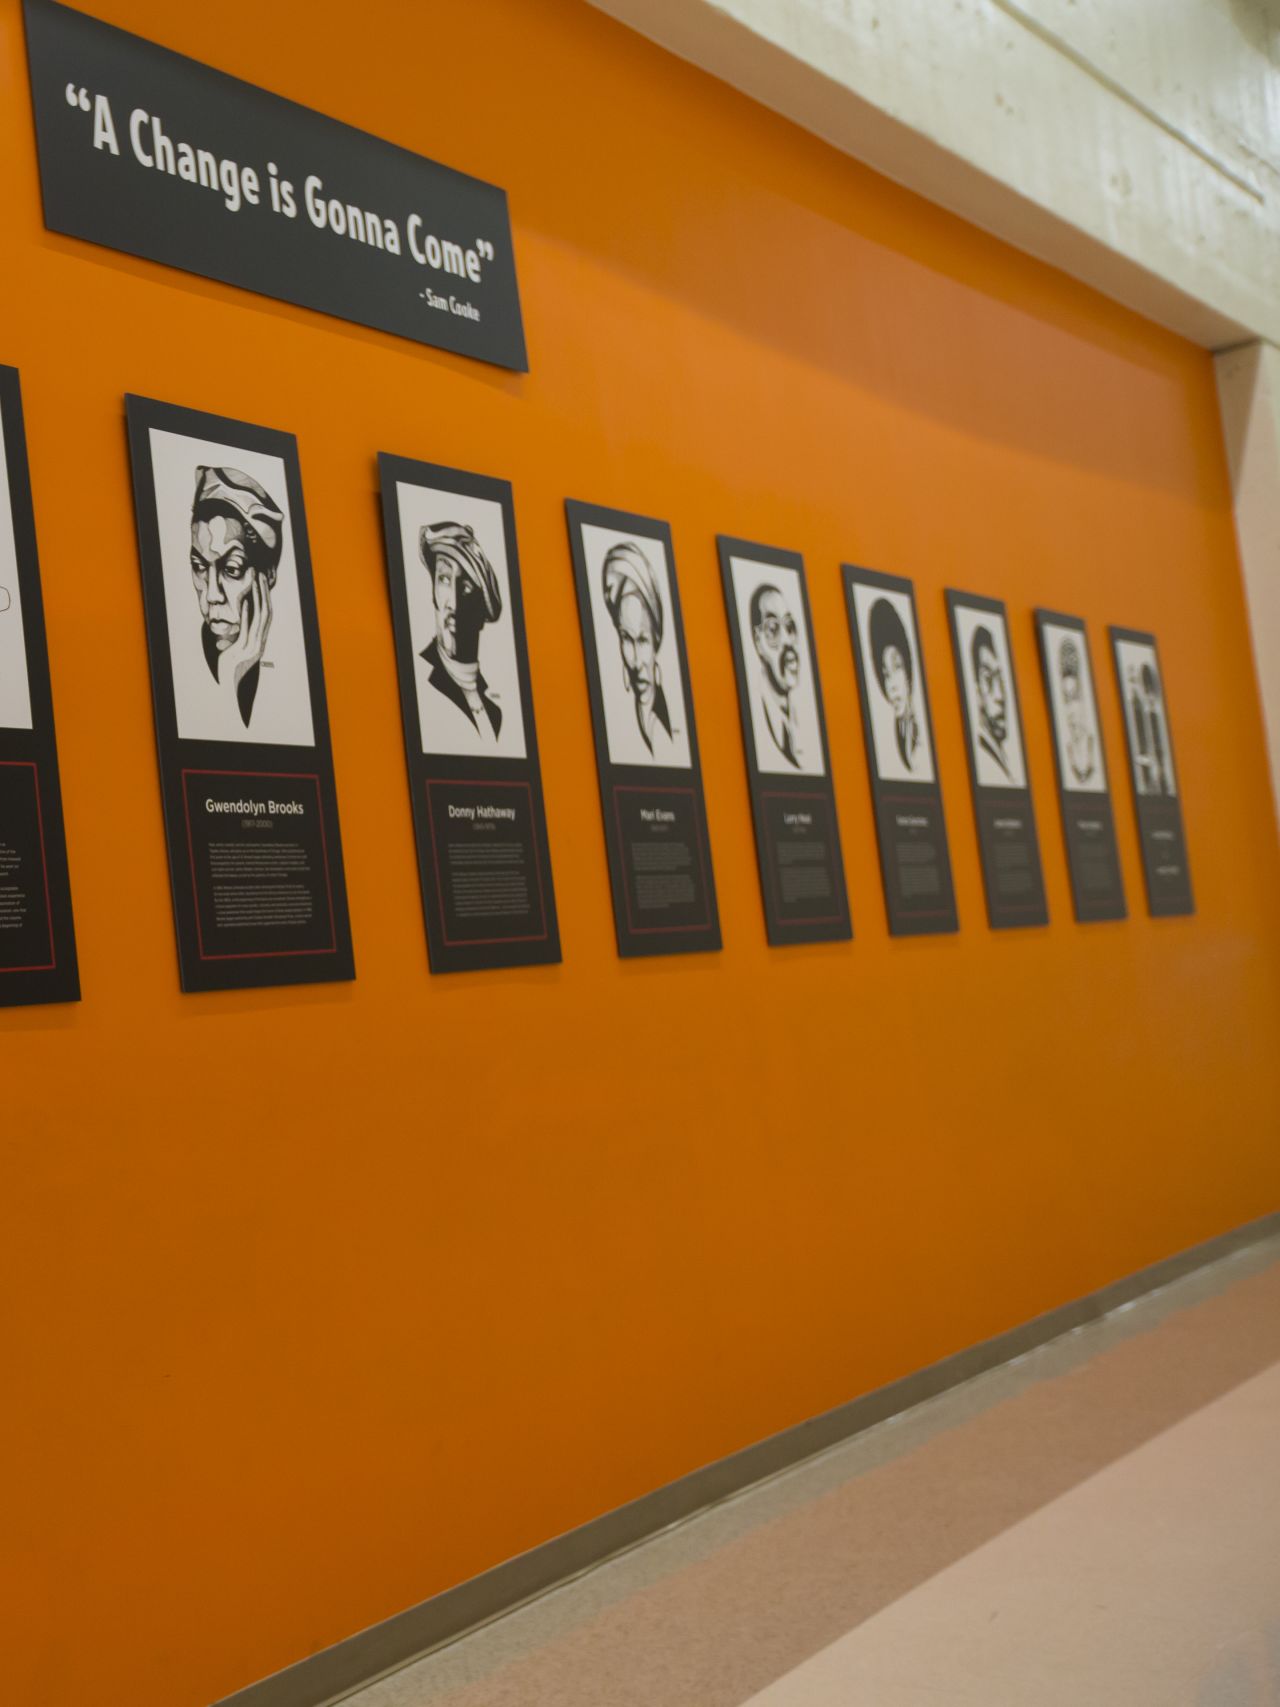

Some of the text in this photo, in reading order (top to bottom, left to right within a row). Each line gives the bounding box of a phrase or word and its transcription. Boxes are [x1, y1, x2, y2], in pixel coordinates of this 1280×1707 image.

[65, 83, 494, 283] “A Change is Gonna Come”
[425, 287, 449, 312] Sam
[449, 295, 481, 322] Cooke
[205, 798, 304, 816] Gwendolyn Brooks
[448, 804, 516, 821] Donny Hathaway
